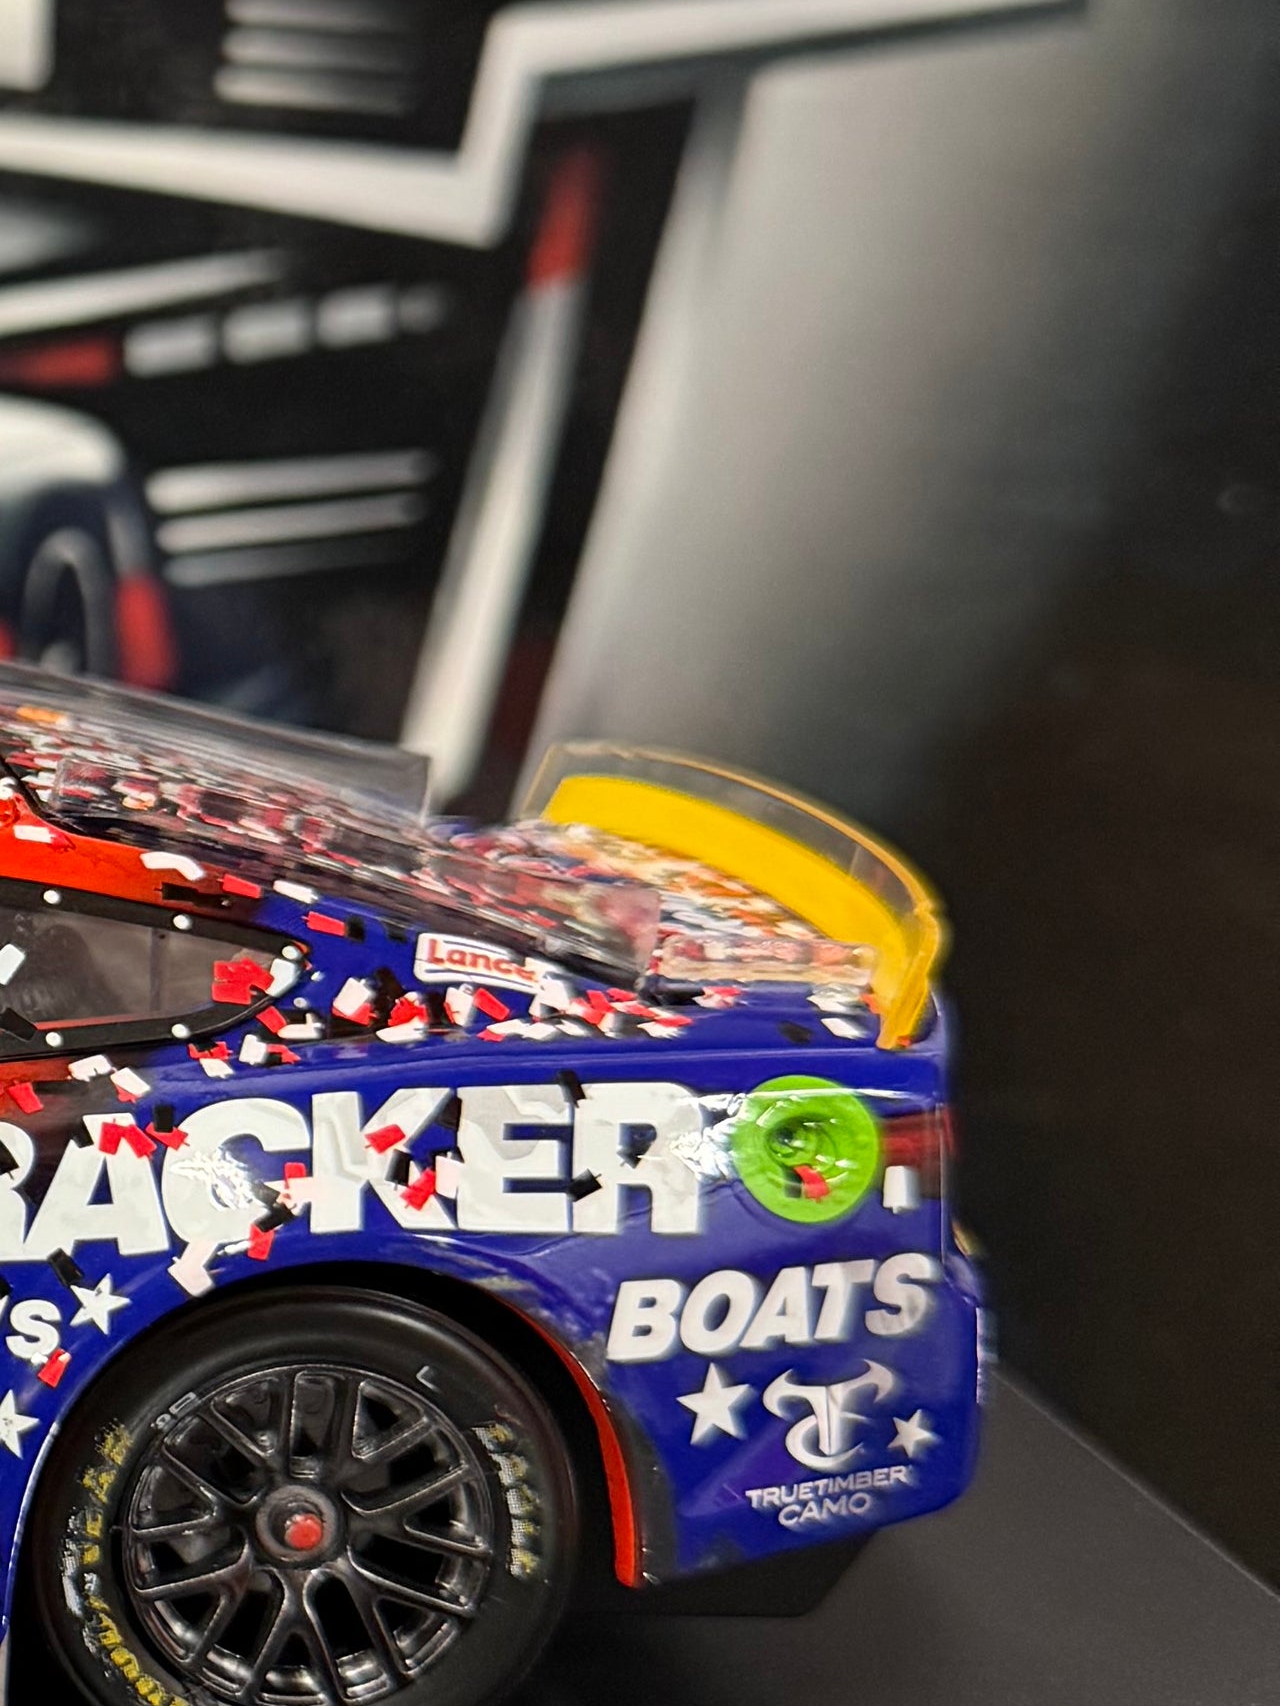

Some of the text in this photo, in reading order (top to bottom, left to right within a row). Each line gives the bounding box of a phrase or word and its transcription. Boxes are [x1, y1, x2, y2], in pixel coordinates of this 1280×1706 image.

[426, 938, 539, 983] Lance
[606, 1251, 937, 1363] BOATS
[745, 1464, 912, 1508] TRUETIMBER
[777, 1491, 873, 1528] CAMO
